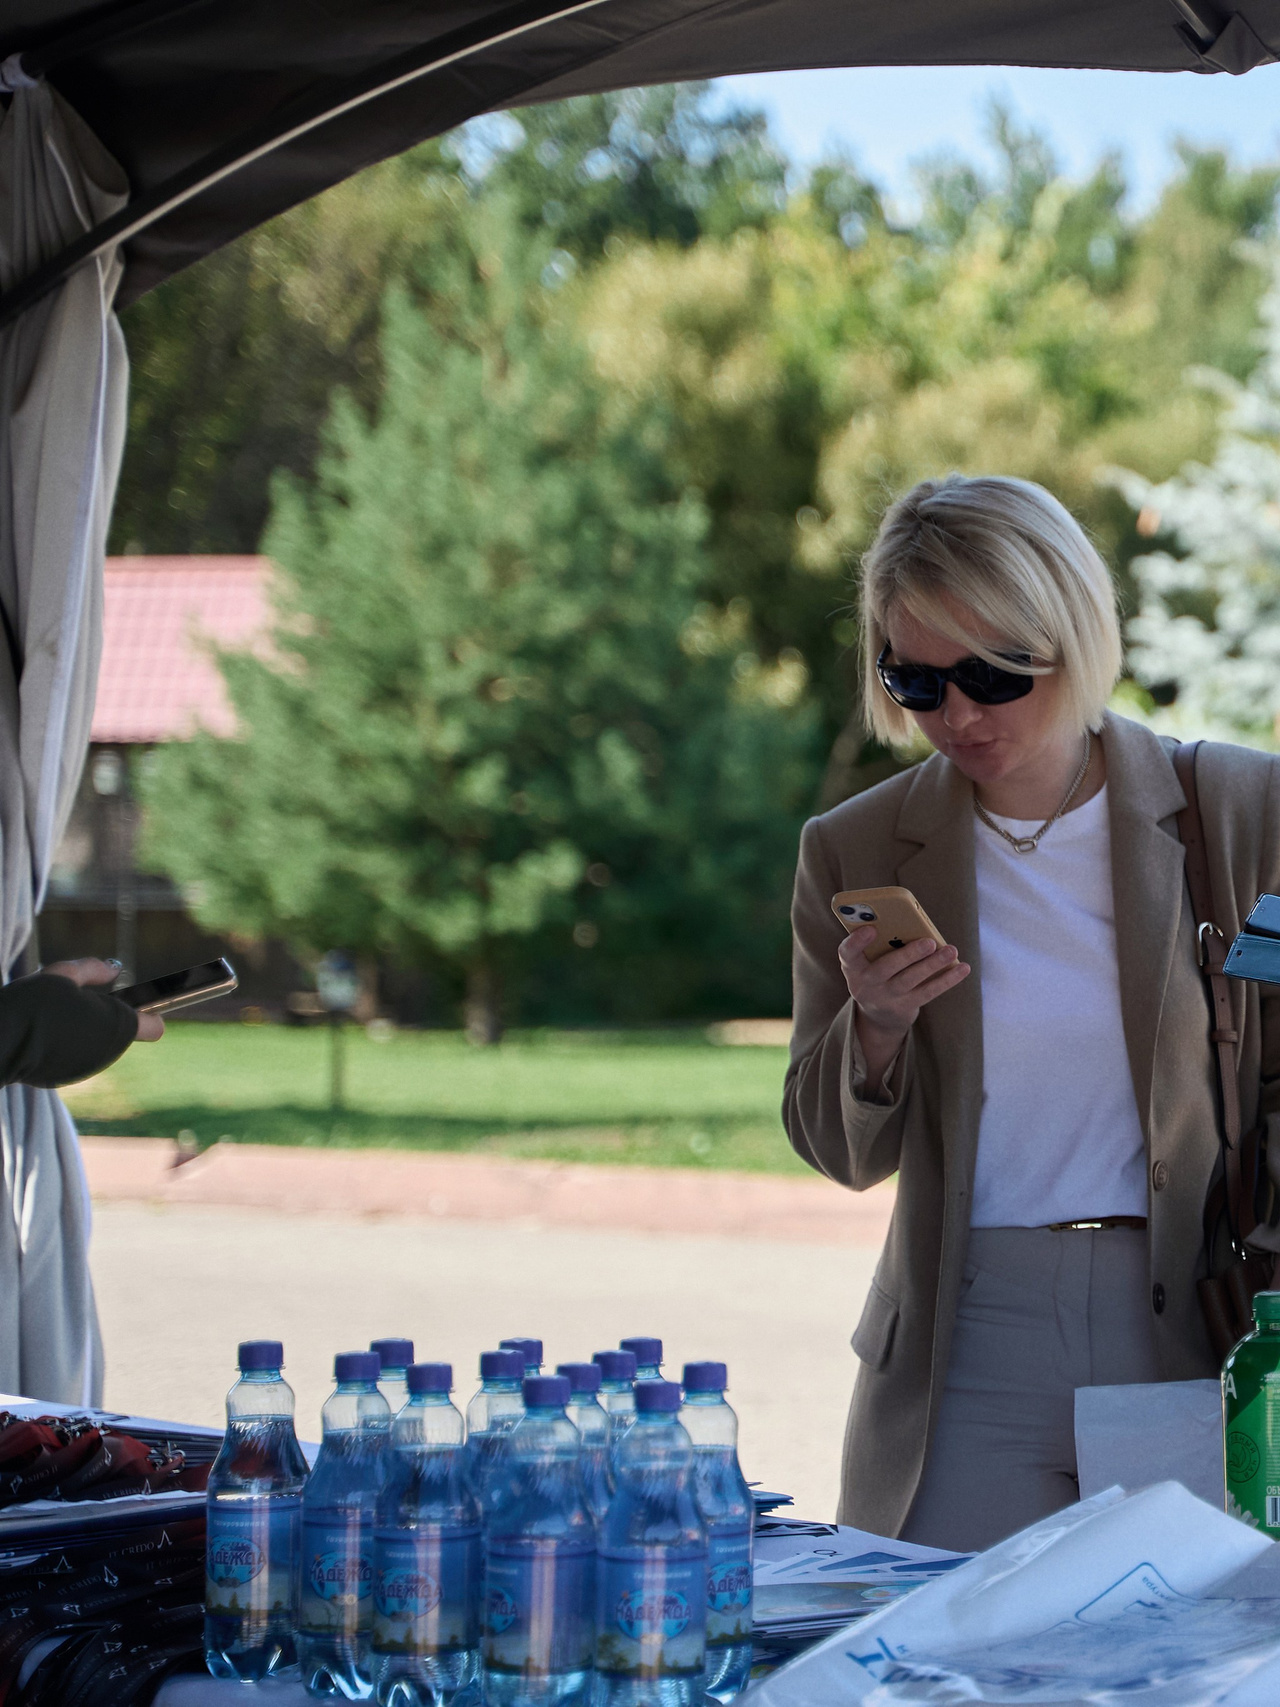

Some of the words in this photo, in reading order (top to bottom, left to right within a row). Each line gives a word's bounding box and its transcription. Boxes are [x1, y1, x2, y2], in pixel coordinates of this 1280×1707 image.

[109, 1551, 119, 1559] IT
[122, 1541, 155, 1556] CREDO
[309, 1566, 373, 1582] НАДЕЖД
